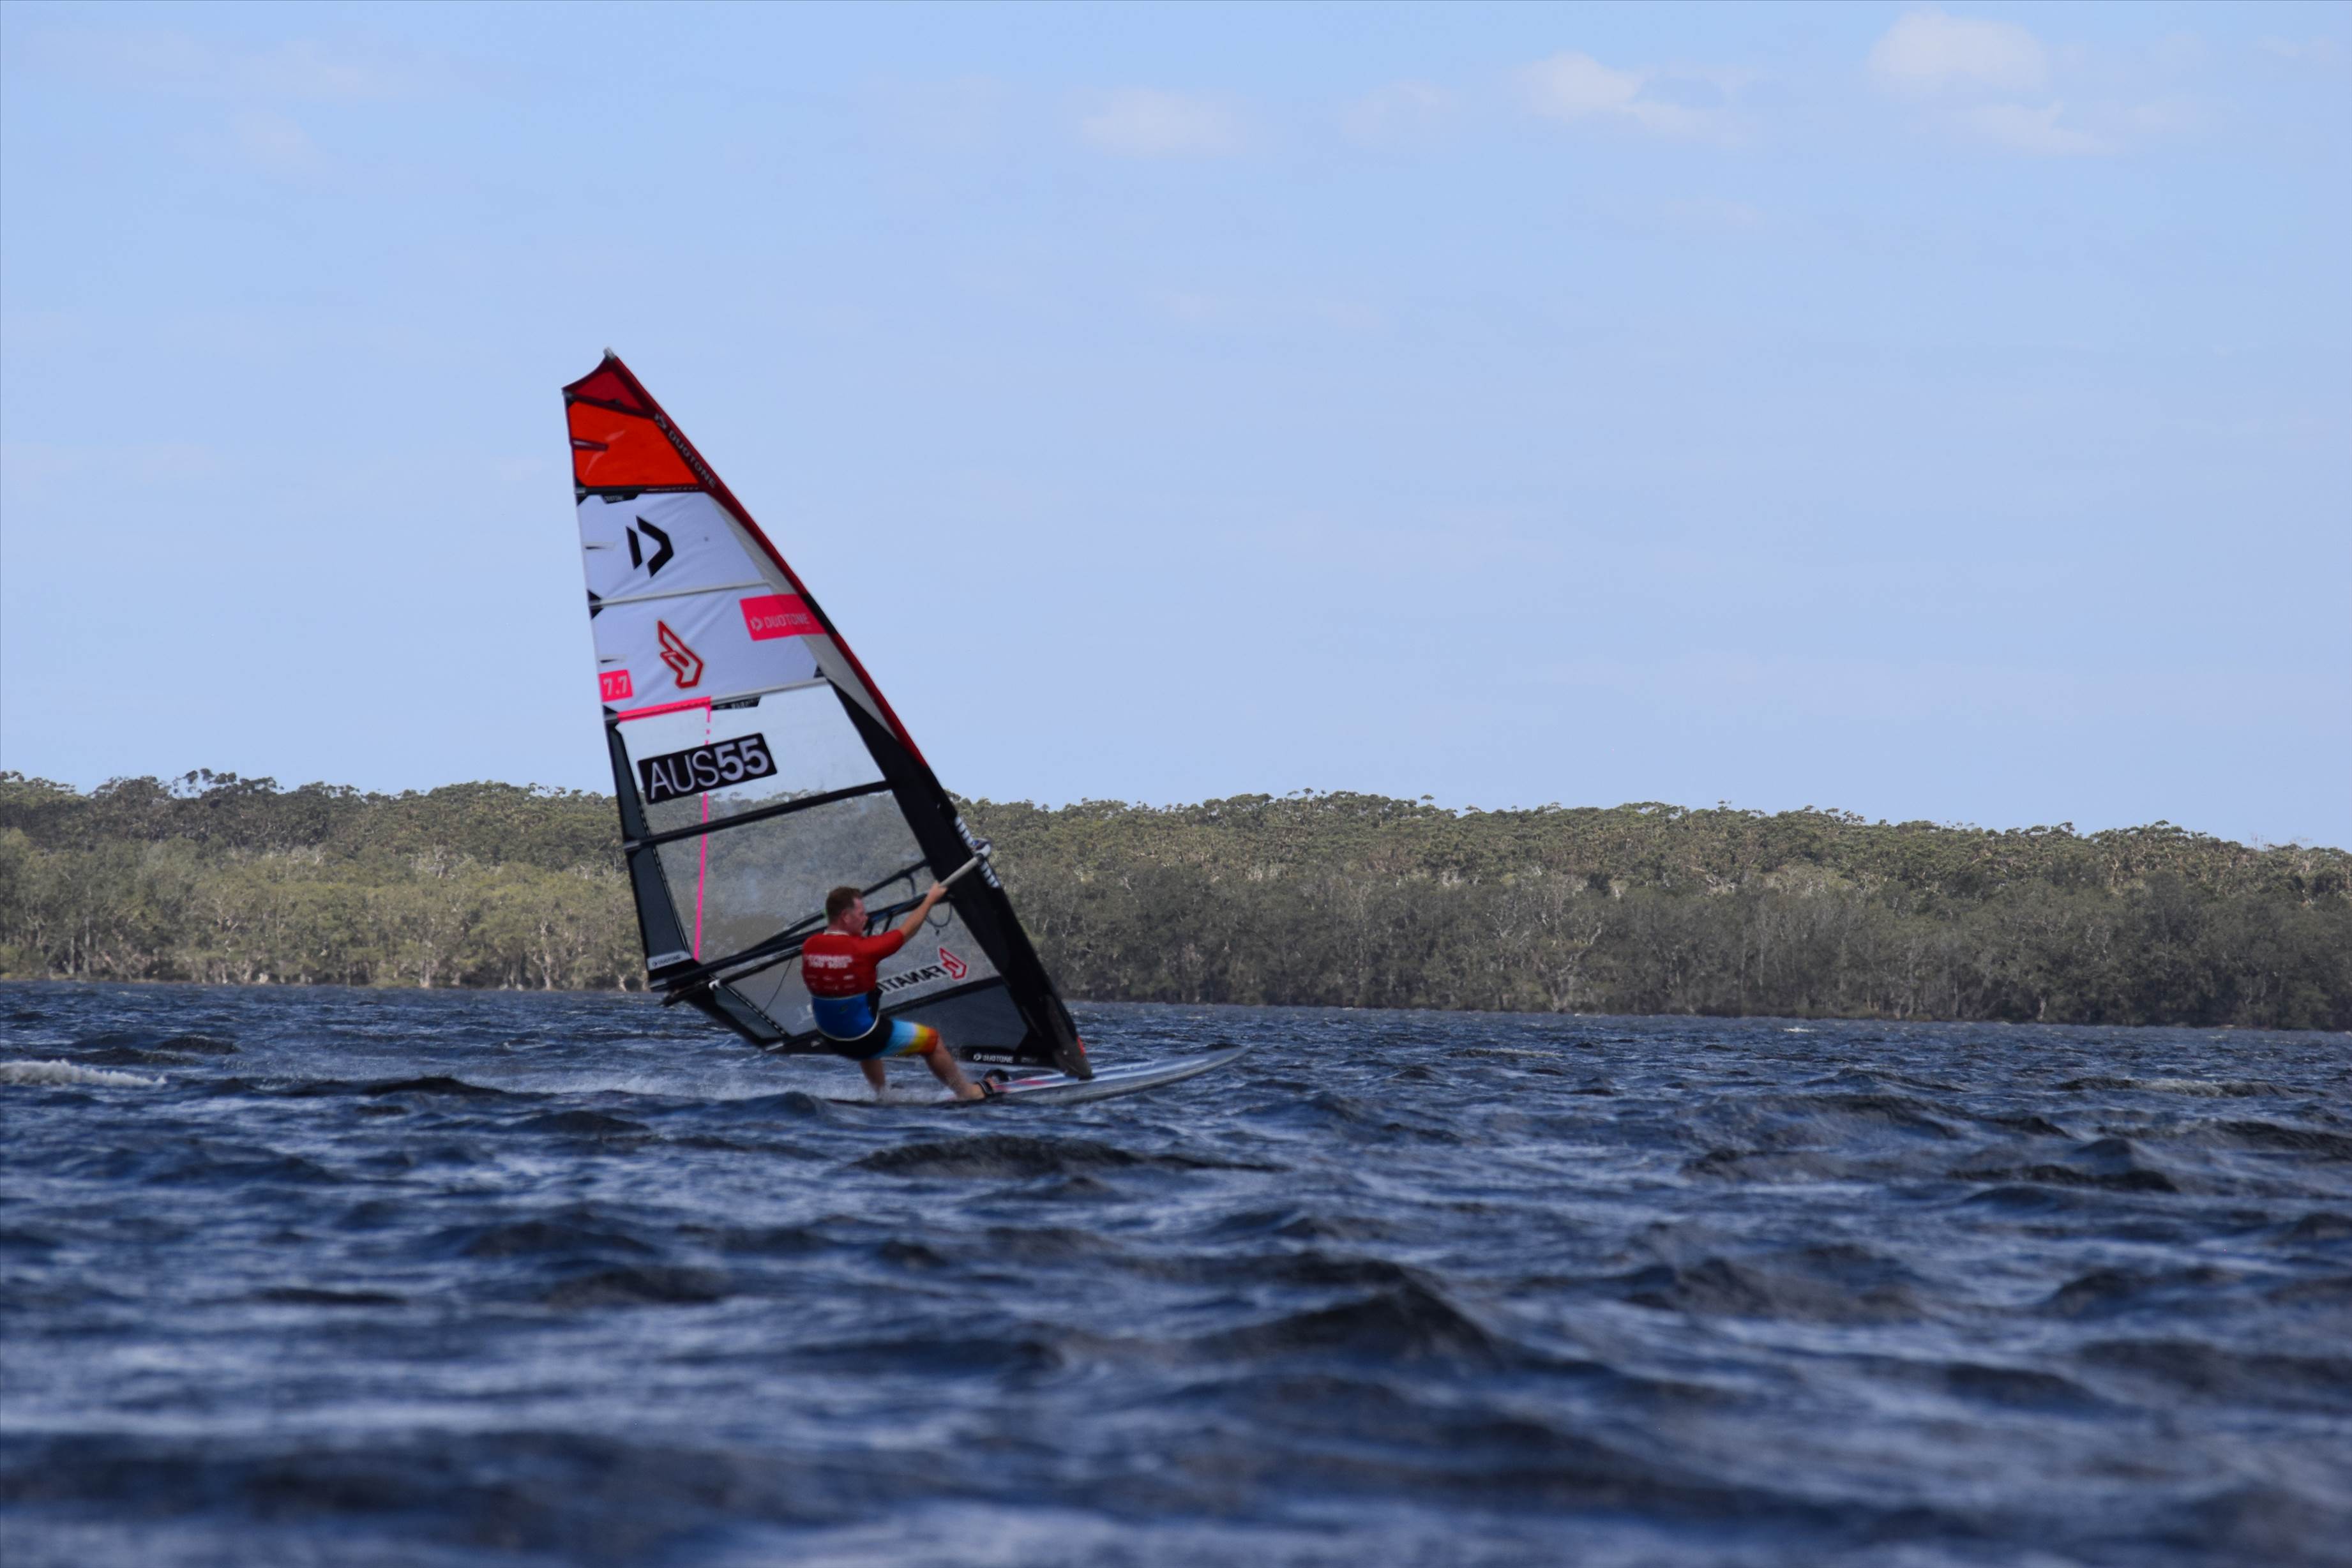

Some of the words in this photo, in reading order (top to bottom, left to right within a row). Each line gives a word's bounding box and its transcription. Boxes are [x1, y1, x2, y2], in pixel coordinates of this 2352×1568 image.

[764, 613, 810, 629] DUOTONE
[603, 675, 628, 696] 7.7
[651, 738, 769, 799] AUS55
